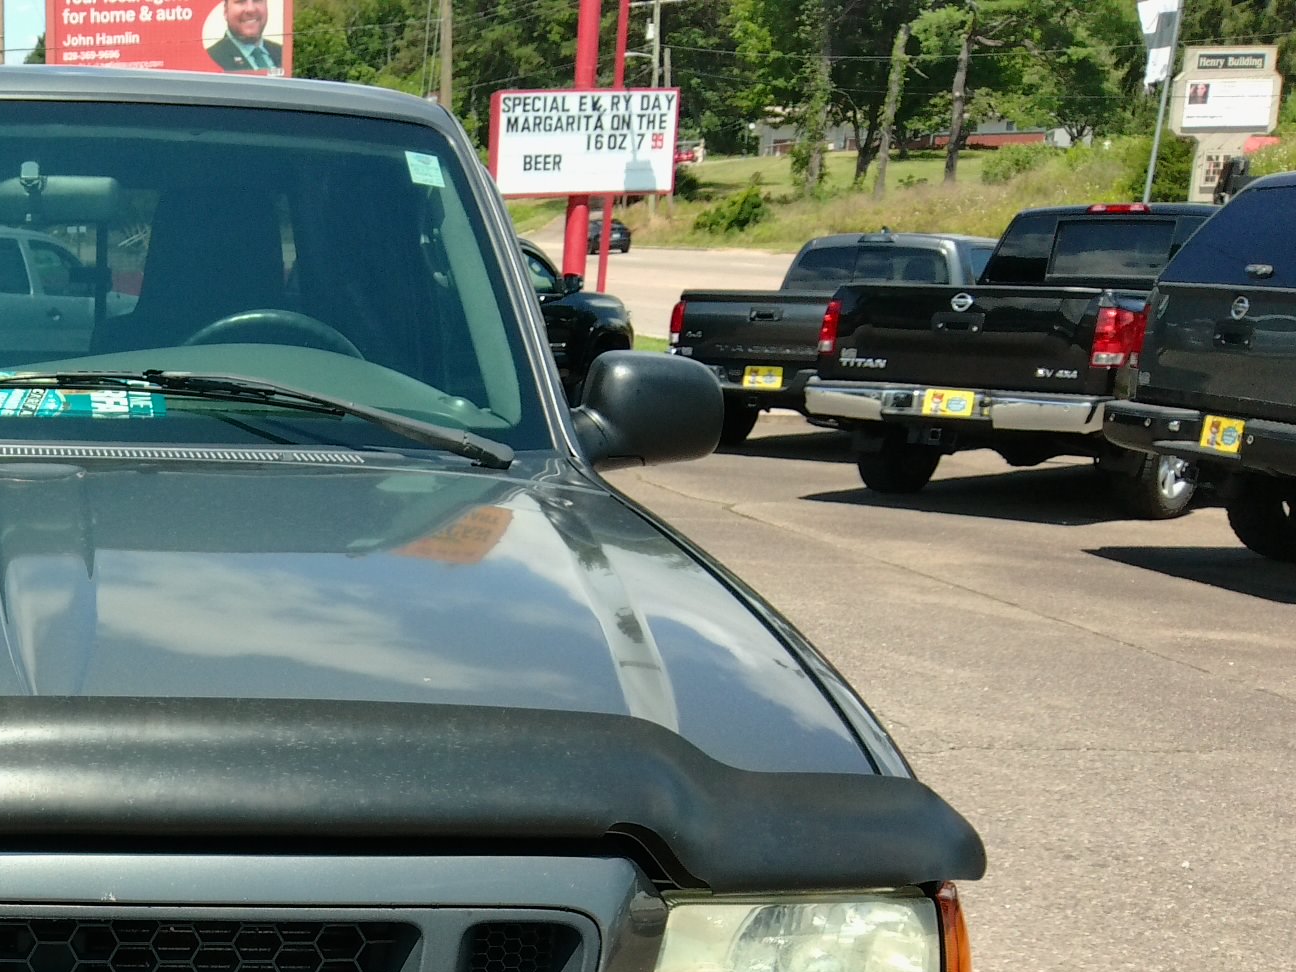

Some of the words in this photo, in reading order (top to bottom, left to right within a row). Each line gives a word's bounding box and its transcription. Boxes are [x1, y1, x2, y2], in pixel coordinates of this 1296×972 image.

[63, 8, 87, 24] for
[90, 7, 135, 23] home
[139, 5, 152, 22] &
[156, 5, 192, 21] auto
[62, 34, 94, 47] John
[95, 31, 140, 46] Hamlin
[1199, 56, 1225, 69] Henry
[1227, 56, 1263, 69] Building
[502, 95, 570, 113] SPECIAL
[640, 94, 675, 112] DAY
[506, 113, 604, 133] MARGARITA
[611, 114, 631, 131] ON
[637, 113, 667, 130] THE
[636, 134, 645, 150] 7
[651, 133, 664, 149] 99
[523, 154, 562, 171] BEER
[839, 357, 887, 369] TITAN
